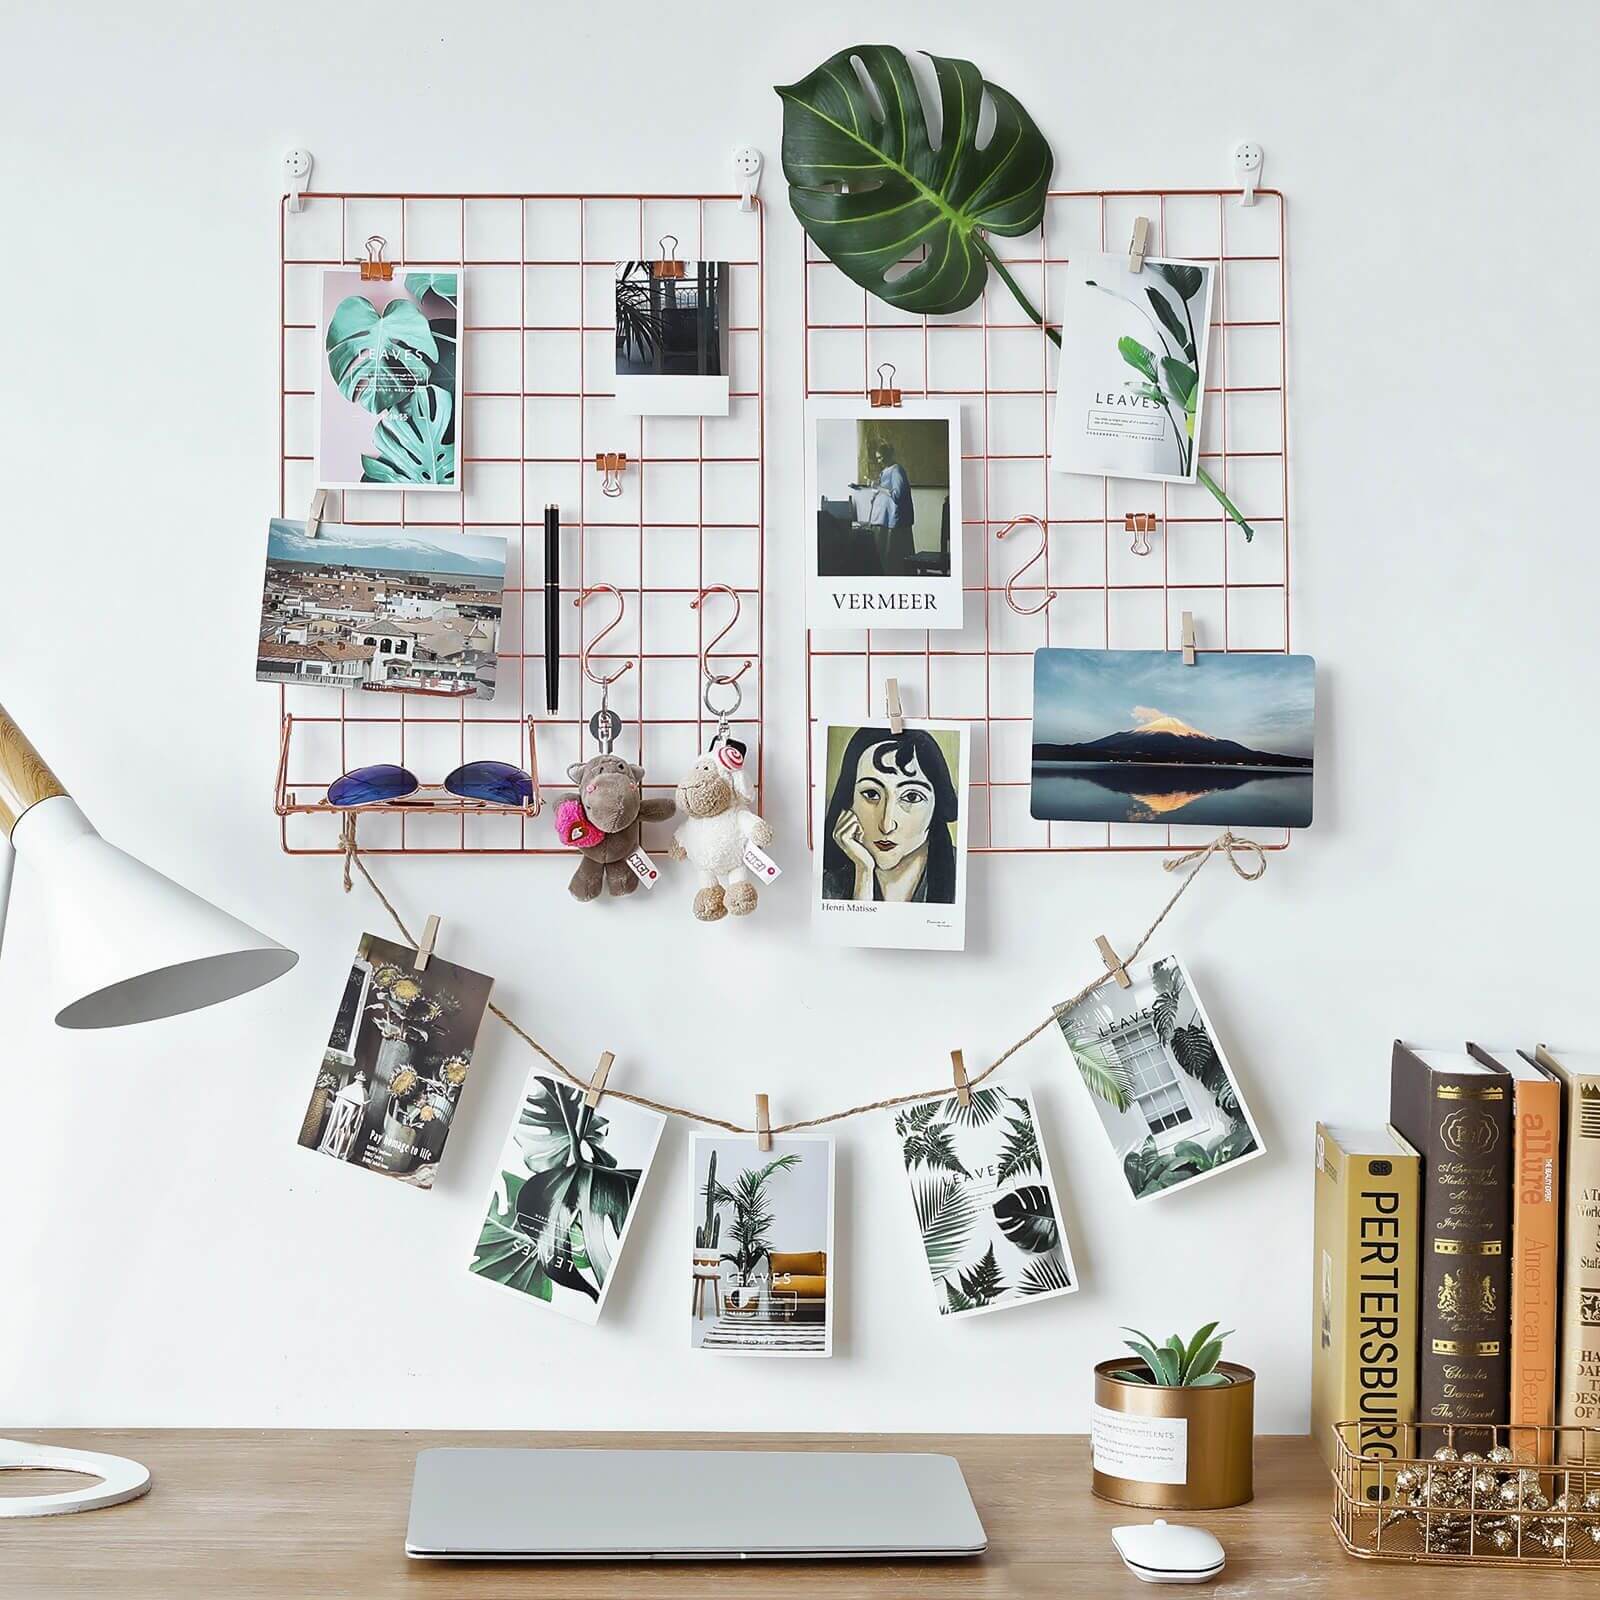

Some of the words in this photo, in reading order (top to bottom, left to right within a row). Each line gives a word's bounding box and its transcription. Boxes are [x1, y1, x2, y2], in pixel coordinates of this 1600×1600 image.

[358, 349, 423, 361] LEAVES
[1095, 392, 1161, 410] LEAVES
[832, 593, 938, 610] VERMEER
[628, 853, 650, 877] NICI
[745, 851, 766, 872] NICI
[821, 903, 845, 912] Henri
[846, 904, 878, 913] Matisse
[369, 1129, 382, 1144] Pay
[1521, 1113, 1552, 1205] allure
[726, 1272, 792, 1285] LEAVES
[1522, 1237, 1550, 1353] American
